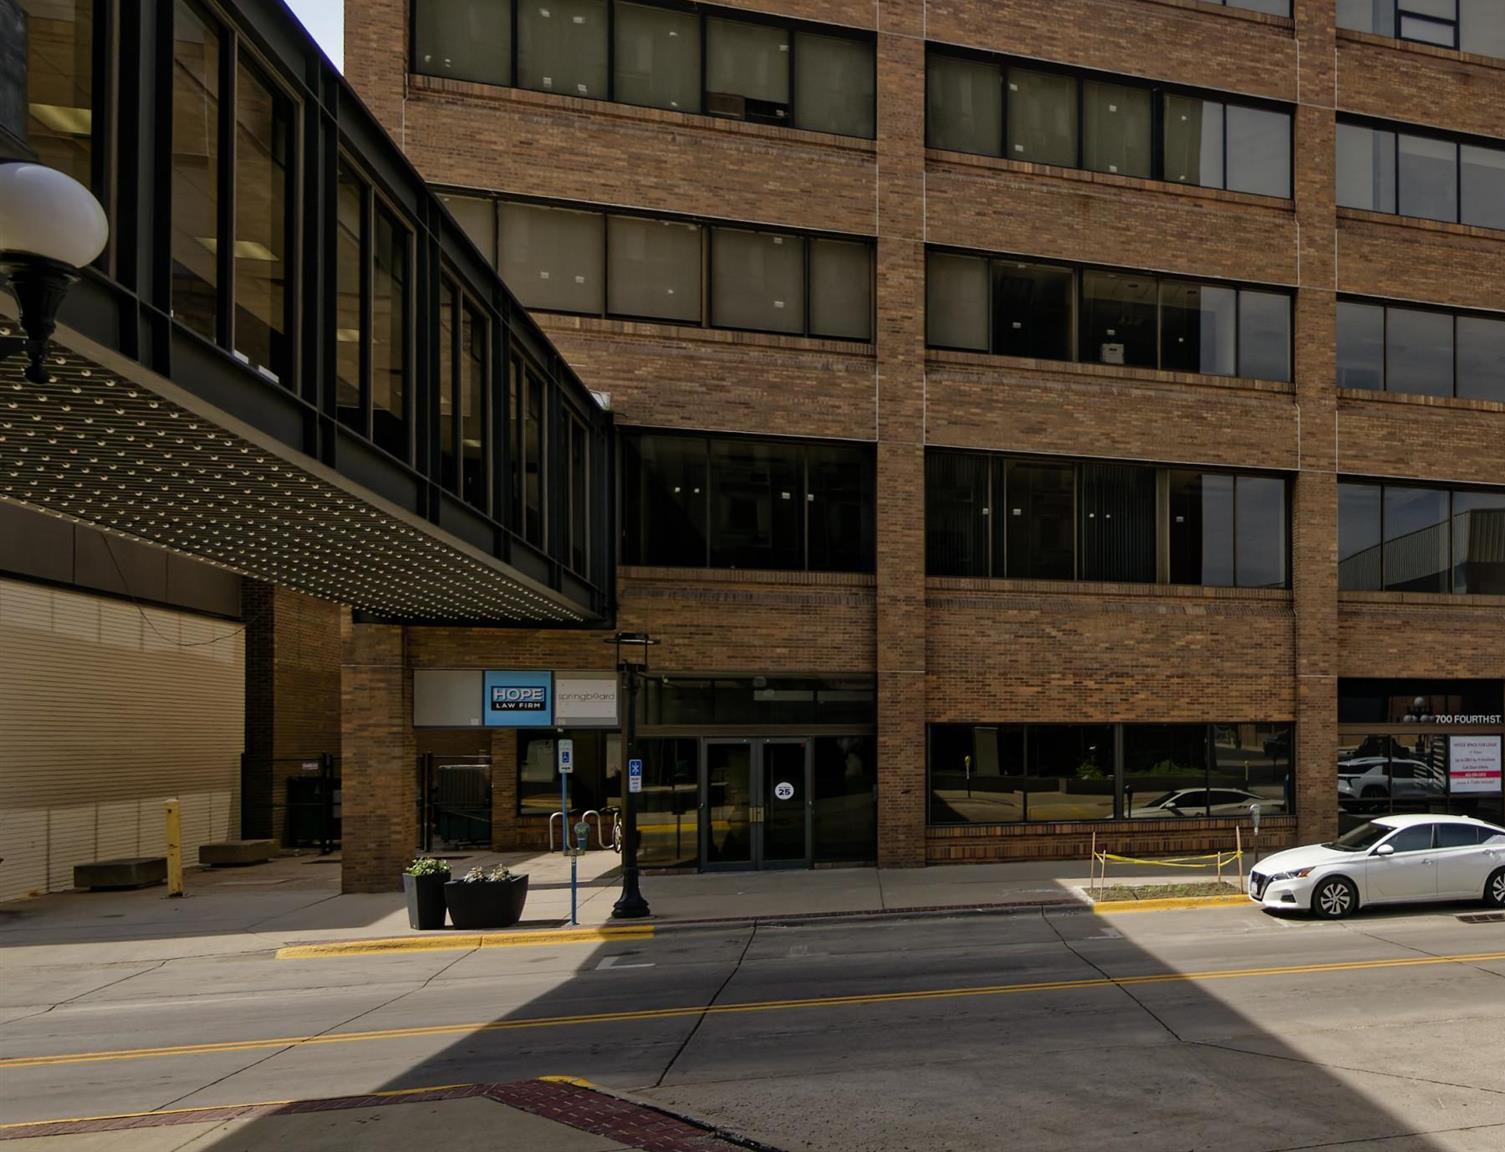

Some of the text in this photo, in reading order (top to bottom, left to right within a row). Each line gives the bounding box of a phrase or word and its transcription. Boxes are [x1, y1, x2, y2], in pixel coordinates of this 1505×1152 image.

[494, 688, 543, 700] HOPE
[1435, 714, 1453, 724] 700
[1454, 714, 1490, 724] FOURTH
[778, 788, 790, 796] 25
